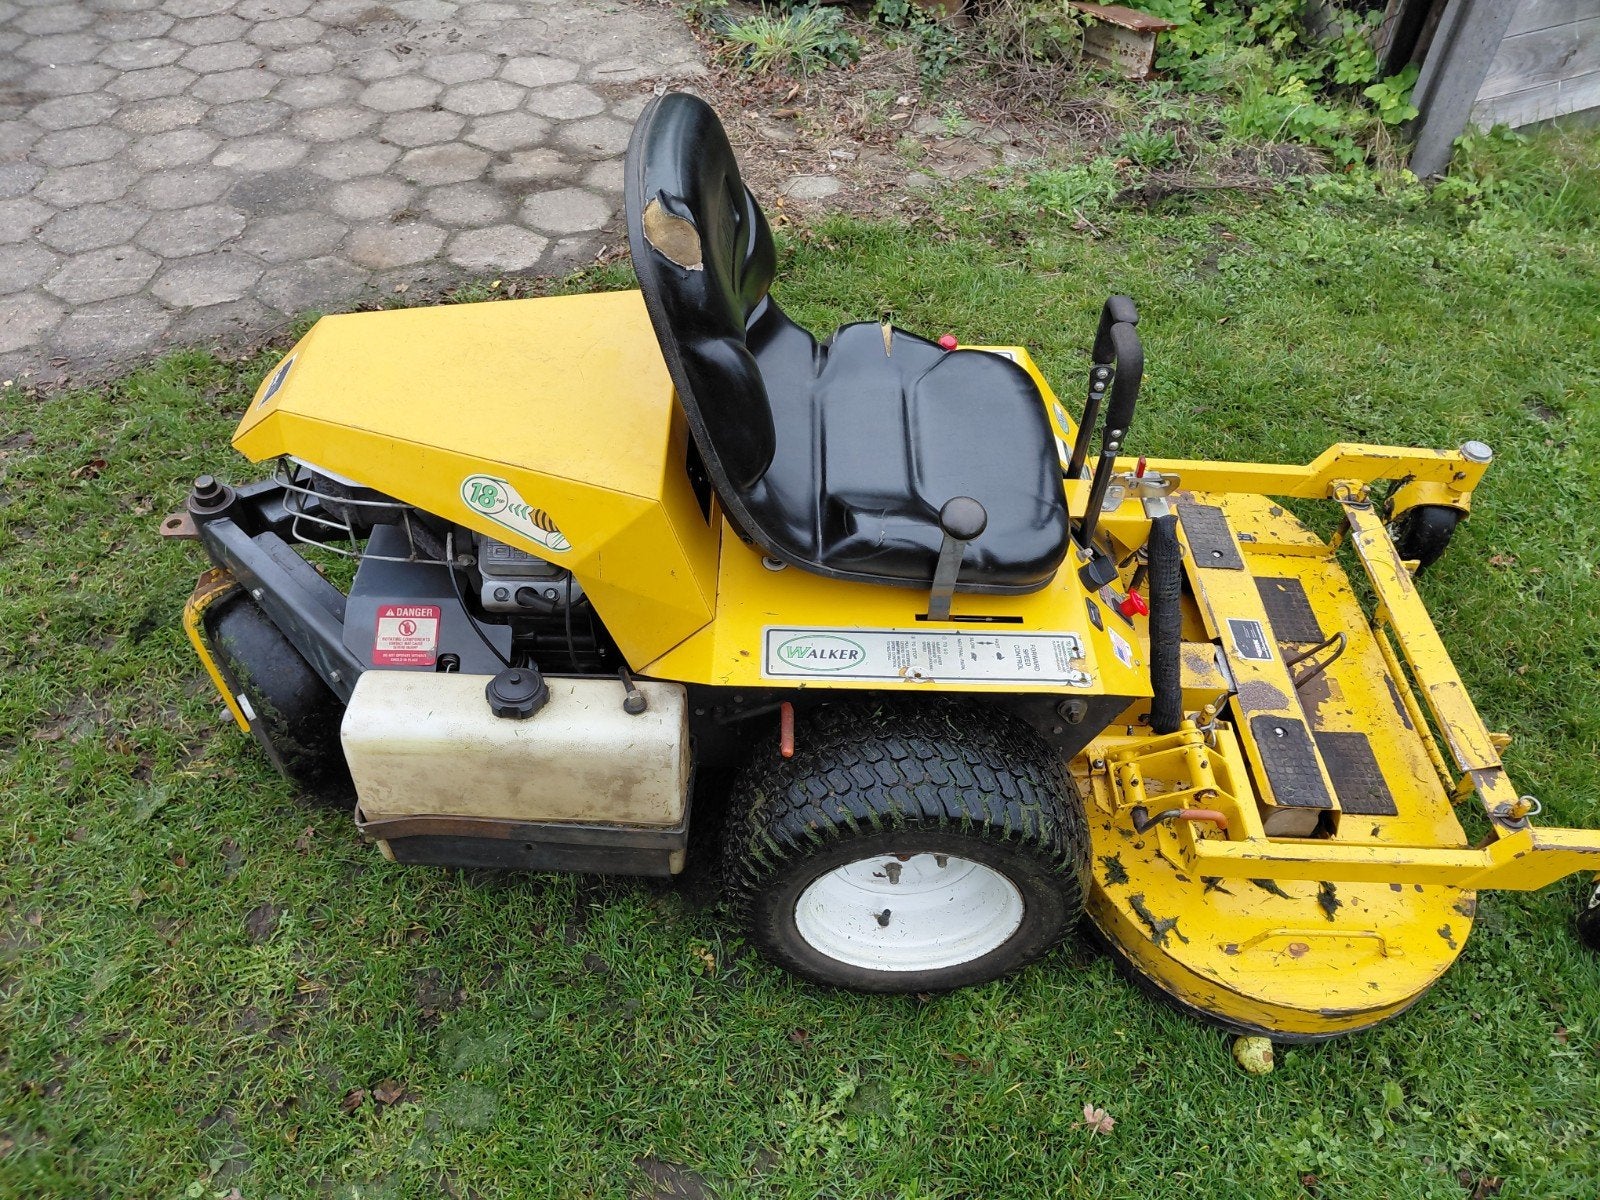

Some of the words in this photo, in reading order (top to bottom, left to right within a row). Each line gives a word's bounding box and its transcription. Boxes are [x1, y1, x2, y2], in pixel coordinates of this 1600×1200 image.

[471, 482, 498, 508] 18
[396, 607, 433, 617] DANGER
[786, 645, 859, 660] WALKER
[1013, 644, 1023, 671] CONTROL
[1022, 648, 1031, 667] SPEED
[1031, 644, 1040, 672] FORWARD
